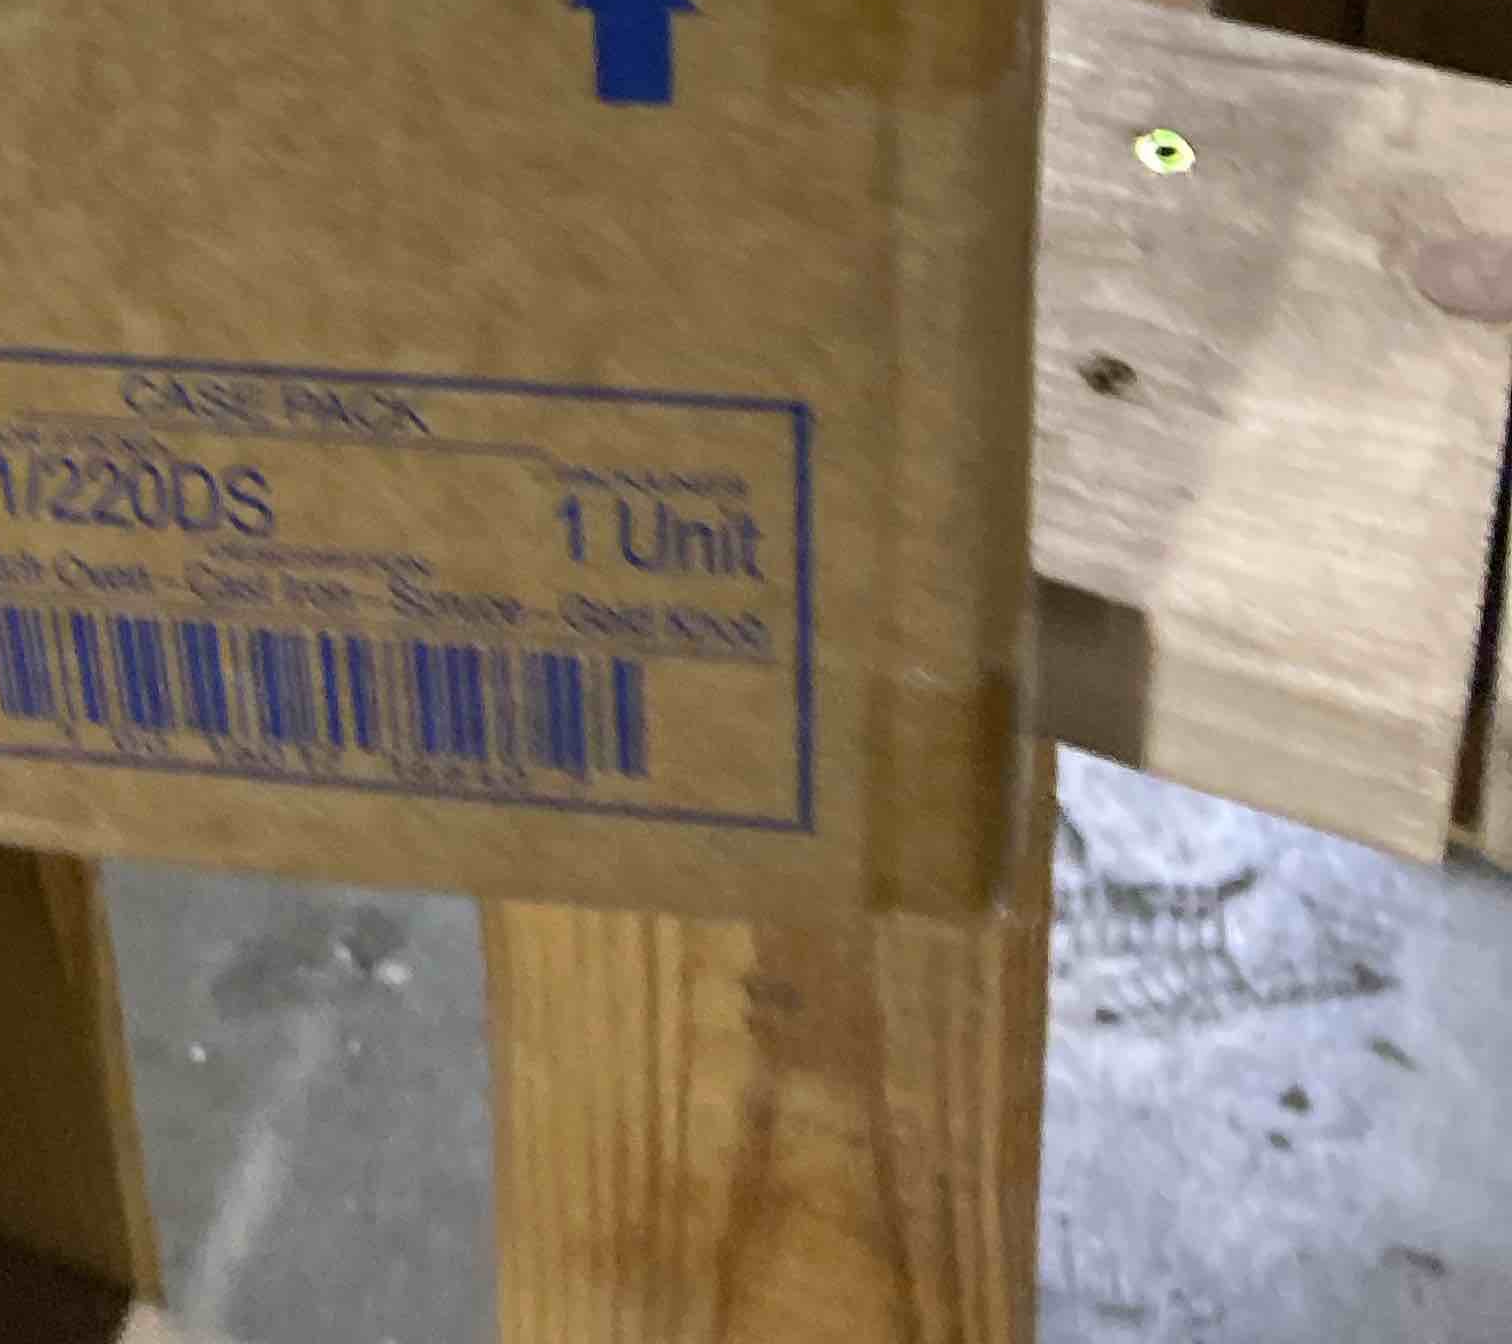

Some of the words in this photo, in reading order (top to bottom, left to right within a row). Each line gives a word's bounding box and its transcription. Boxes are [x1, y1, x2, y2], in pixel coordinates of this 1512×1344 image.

[121, 372, 268, 427] CASE
[282, 384, 433, 436] PACK
[558, 494, 586, 562] 1
[616, 498, 767, 584] Unit
